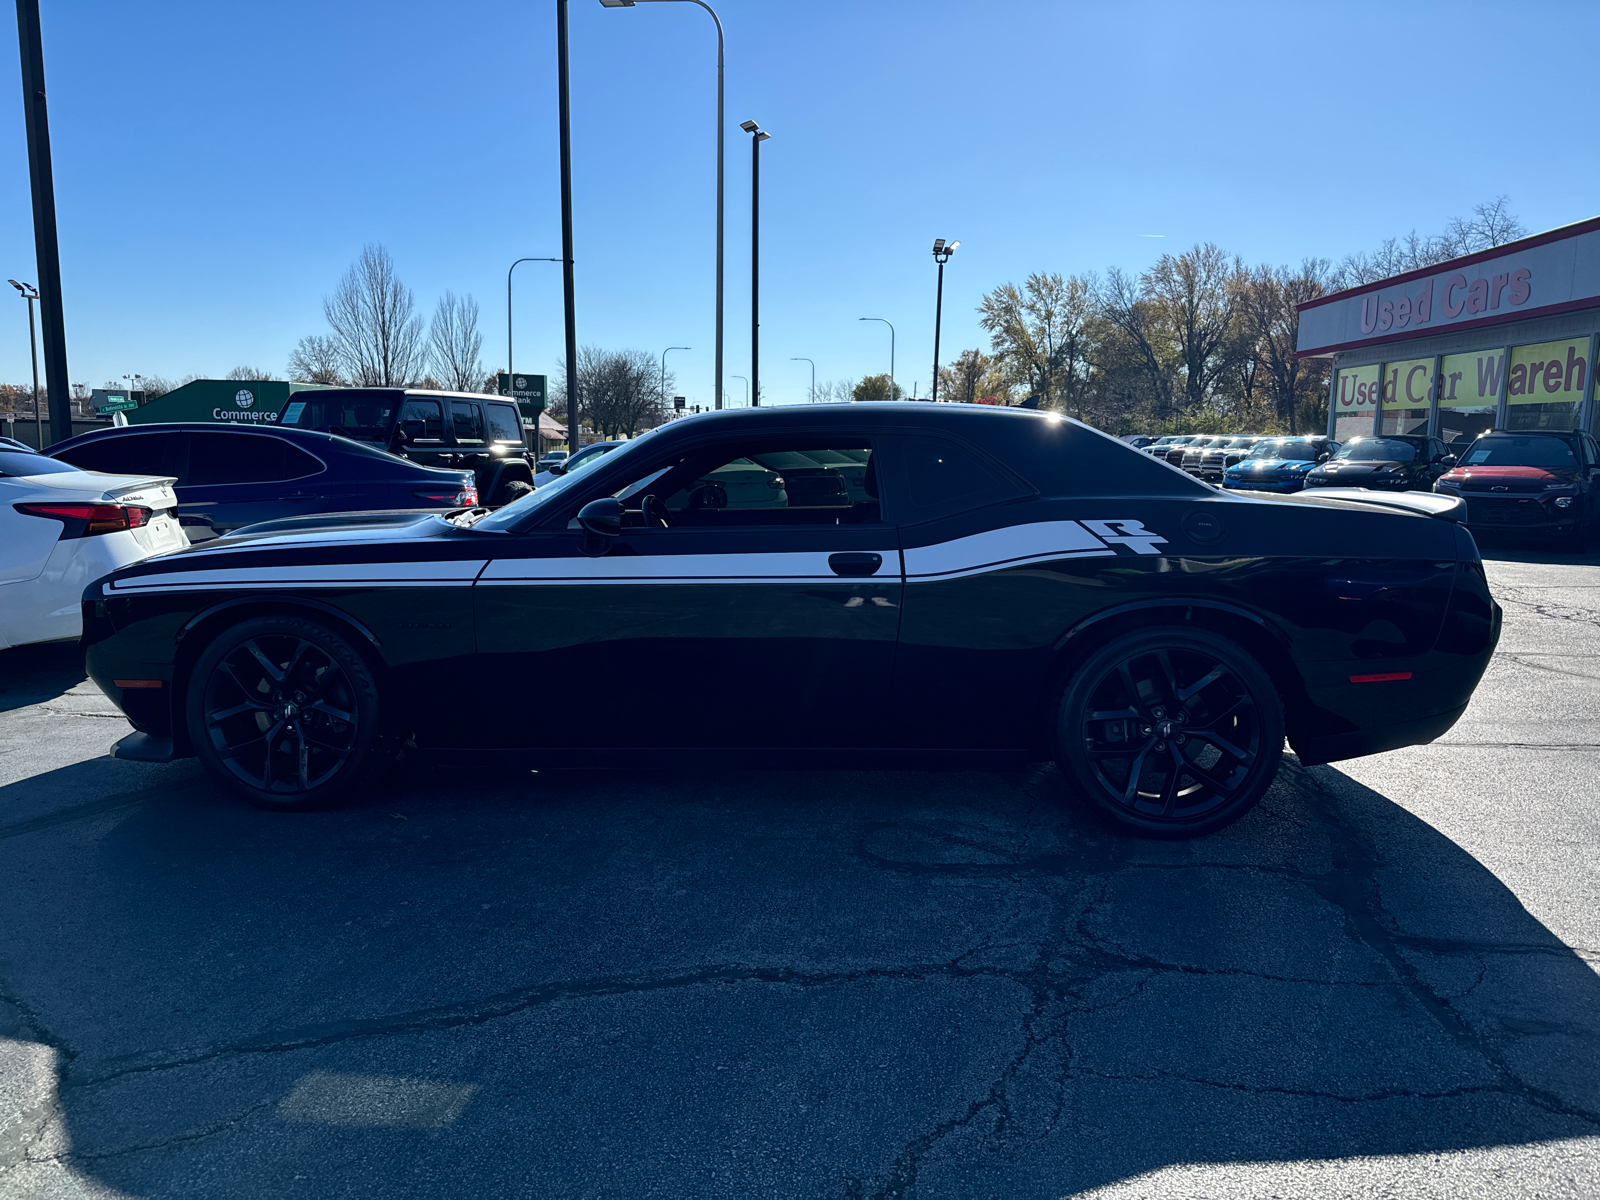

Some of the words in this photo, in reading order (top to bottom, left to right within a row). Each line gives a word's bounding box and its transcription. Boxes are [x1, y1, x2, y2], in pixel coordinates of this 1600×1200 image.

[1360, 278, 1434, 334] Used
[1442, 268, 1531, 318] Cars
[1340, 368, 1398, 407] Used
[1405, 365, 1462, 403] Car
[1477, 346, 1600, 398] Wareh
[212, 407, 278, 420] Commerce
